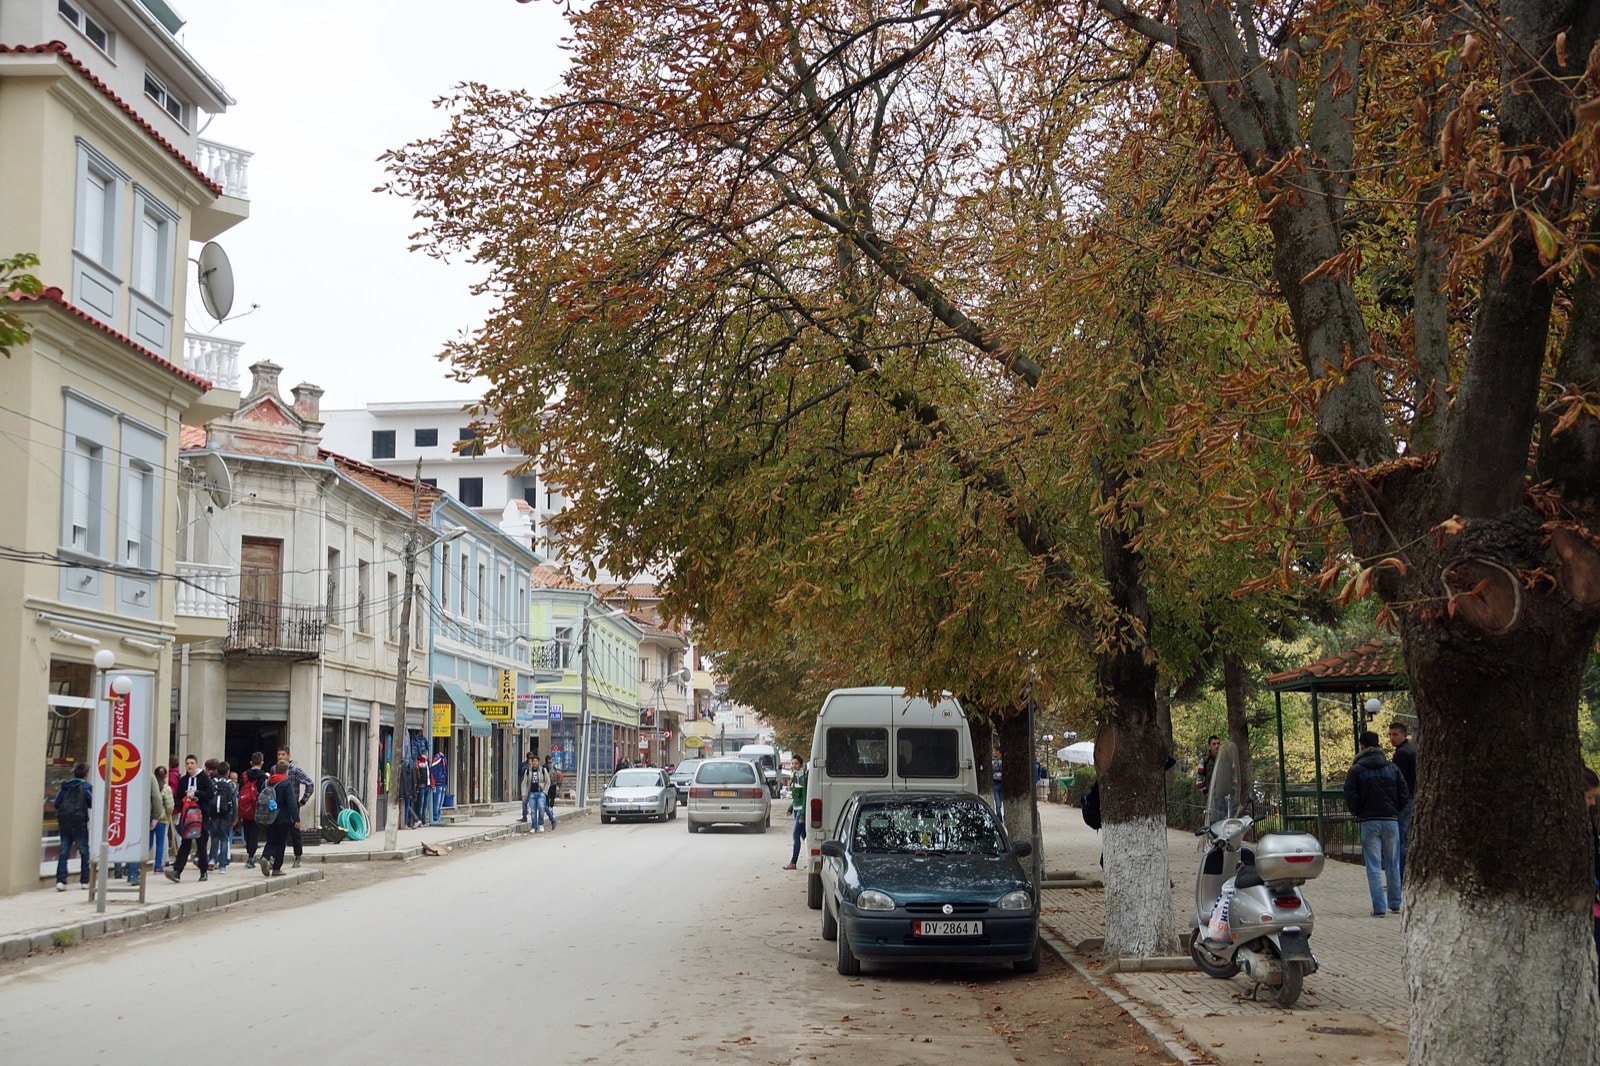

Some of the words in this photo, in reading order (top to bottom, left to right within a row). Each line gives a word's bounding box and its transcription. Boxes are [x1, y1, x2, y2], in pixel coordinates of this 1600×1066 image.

[503, 669, 511, 703] EXCHA
[108, 788, 124, 841] Dajana
[943, 922, 968, 934] 2864
[973, 922, 979, 934] A
